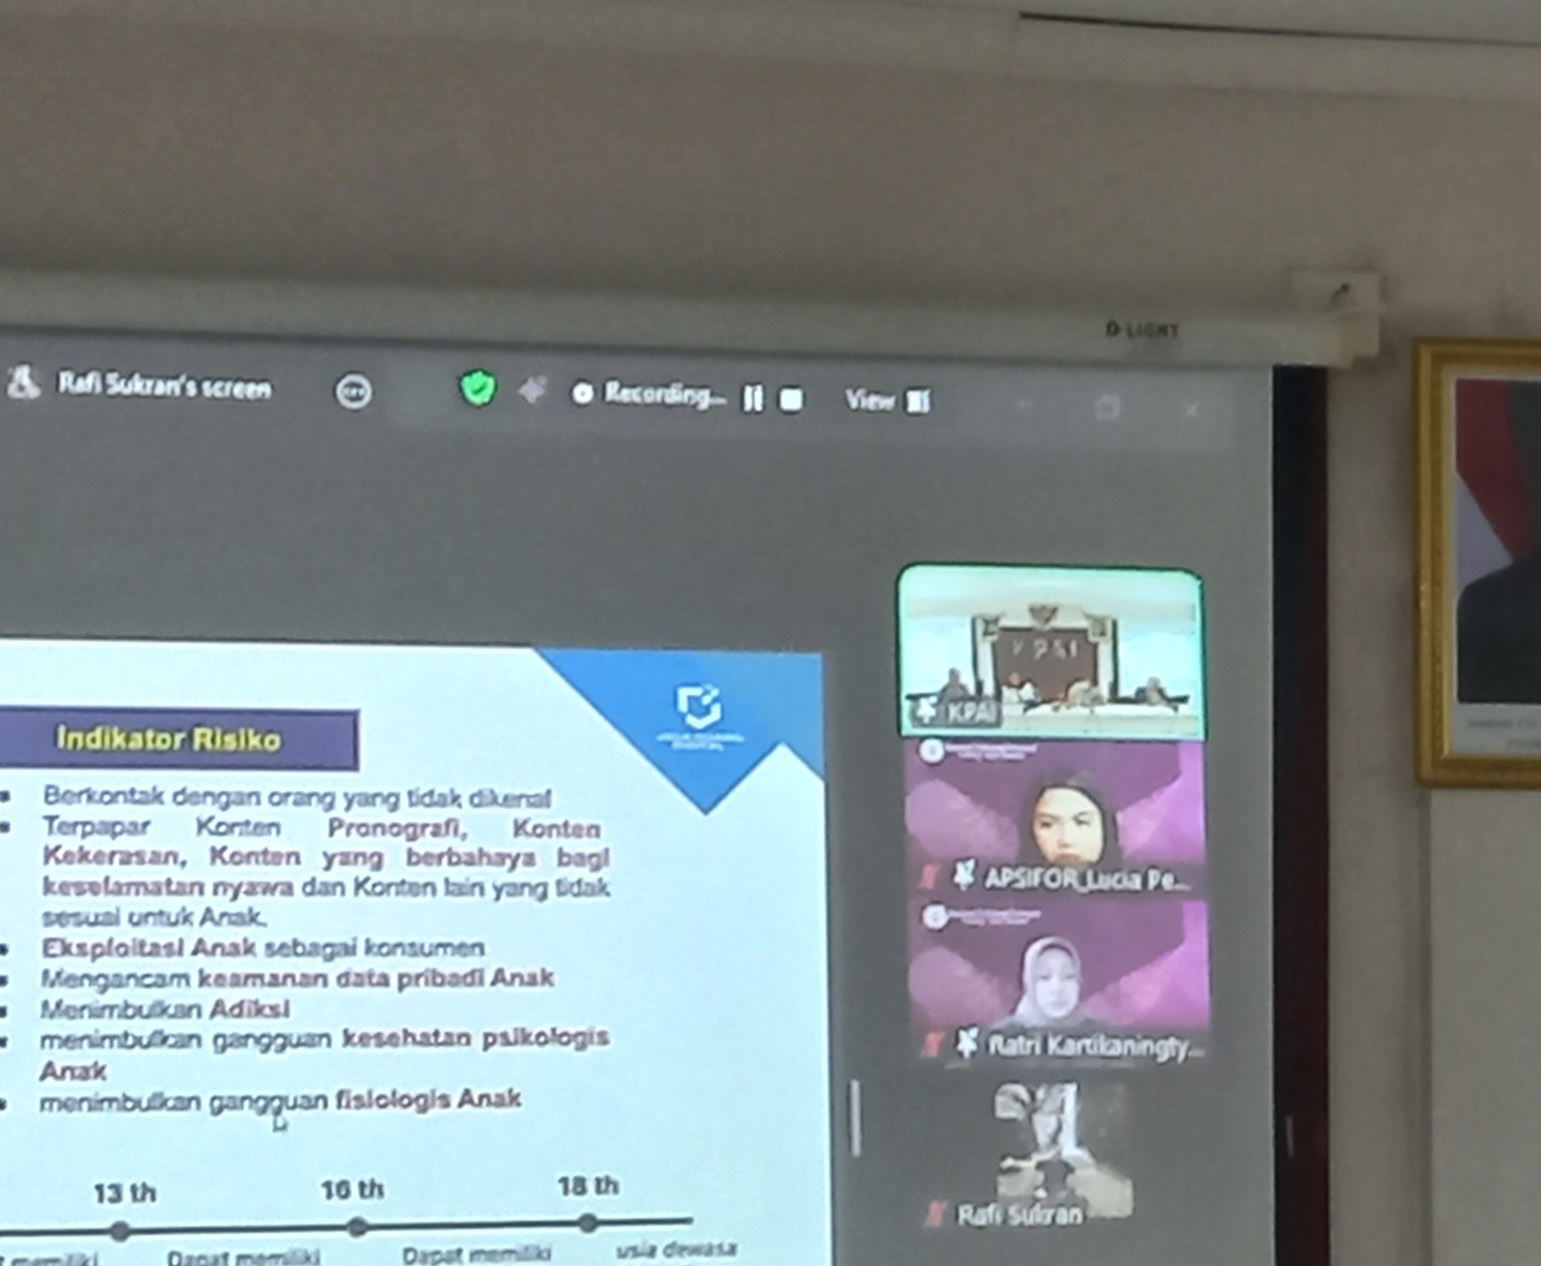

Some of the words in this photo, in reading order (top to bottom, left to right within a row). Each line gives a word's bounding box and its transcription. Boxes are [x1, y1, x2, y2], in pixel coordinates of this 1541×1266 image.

[59, 371, 101, 395] Rafi
[106, 373, 196, 396] Sukran's
[202, 378, 272, 398] screen
[846, 389, 895, 410] View
[949, 703, 997, 723] KPAI
[57, 725, 184, 751] Indikator
[193, 728, 282, 753] Risiko
[44, 785, 164, 806] Berkontak
[172, 786, 260, 812] dengan
[268, 789, 335, 812] orang
[343, 790, 399, 812] yang
[407, 788, 461, 809] tidak
[468, 787, 551, 808] dikenal
[43, 815, 150, 840] Terpapar
[196, 815, 281, 837] Konten
[328, 817, 468, 842] Pronografi,
[513, 817, 601, 839] Konten
[43, 845, 188, 870] Kekerasan,
[209, 846, 302, 867] Konten
[322, 850, 384, 872] yang
[406, 846, 536, 871] berbahaya
[557, 846, 610, 871] bagi
[42, 876, 205, 898] keselamatan
[213, 880, 294, 902] nyawa
[302, 875, 346, 898] dan
[353, 875, 436, 898] Konten
[444, 875, 484, 898] lain
[492, 880, 548, 903] yang
[556, 876, 610, 898] tidak
[985, 867, 1142, 892] APSIFOR_Lucia
[42, 906, 120, 927] sesuai
[128, 906, 194, 927] untuk
[200, 905, 267, 928] Anak.
[42, 937, 184, 962] Eksploitasi
[192, 936, 257, 957] Anak
[264, 937, 358, 961] sebagai
[364, 938, 486, 957] konsumen
[40, 968, 191, 993] Mengancam
[198, 967, 328, 989] keamanan
[336, 967, 390, 989] data
[397, 967, 485, 992] pribadi
[490, 968, 555, 989] Anak
[40, 999, 202, 1020] Menimbulkan
[208, 998, 291, 1019] Adiksi
[40, 1030, 202, 1051] menimbulkan
[213, 1031, 332, 1055] gangguan
[342, 1027, 472, 1048] kesehatan
[481, 1026, 610, 1051] psikologis
[39, 1061, 107, 1083] Anak
[39, 1092, 202, 1114] menimbulkan
[209, 1091, 328, 1117] gangguan
[336, 1089, 452, 1113] fisiologis
[457, 1089, 522, 1109] Anak
[95, 1183, 122, 1203] 13
[130, 1182, 157, 1203] th
[322, 1180, 350, 1200] 16
[358, 1178, 384, 1199] th
[558, 1176, 588, 1197] 18
[594, 1175, 620, 1196] th
[958, 1204, 1002, 1226] Rafi
[1009, 1205, 1084, 1226] Sukran
[236, 1249, 321, 1266] memiliki
[469, 1245, 551, 1263] memiliki
[617, 1242, 657, 1260] usia
[662, 1241, 738, 1259] dewasa
